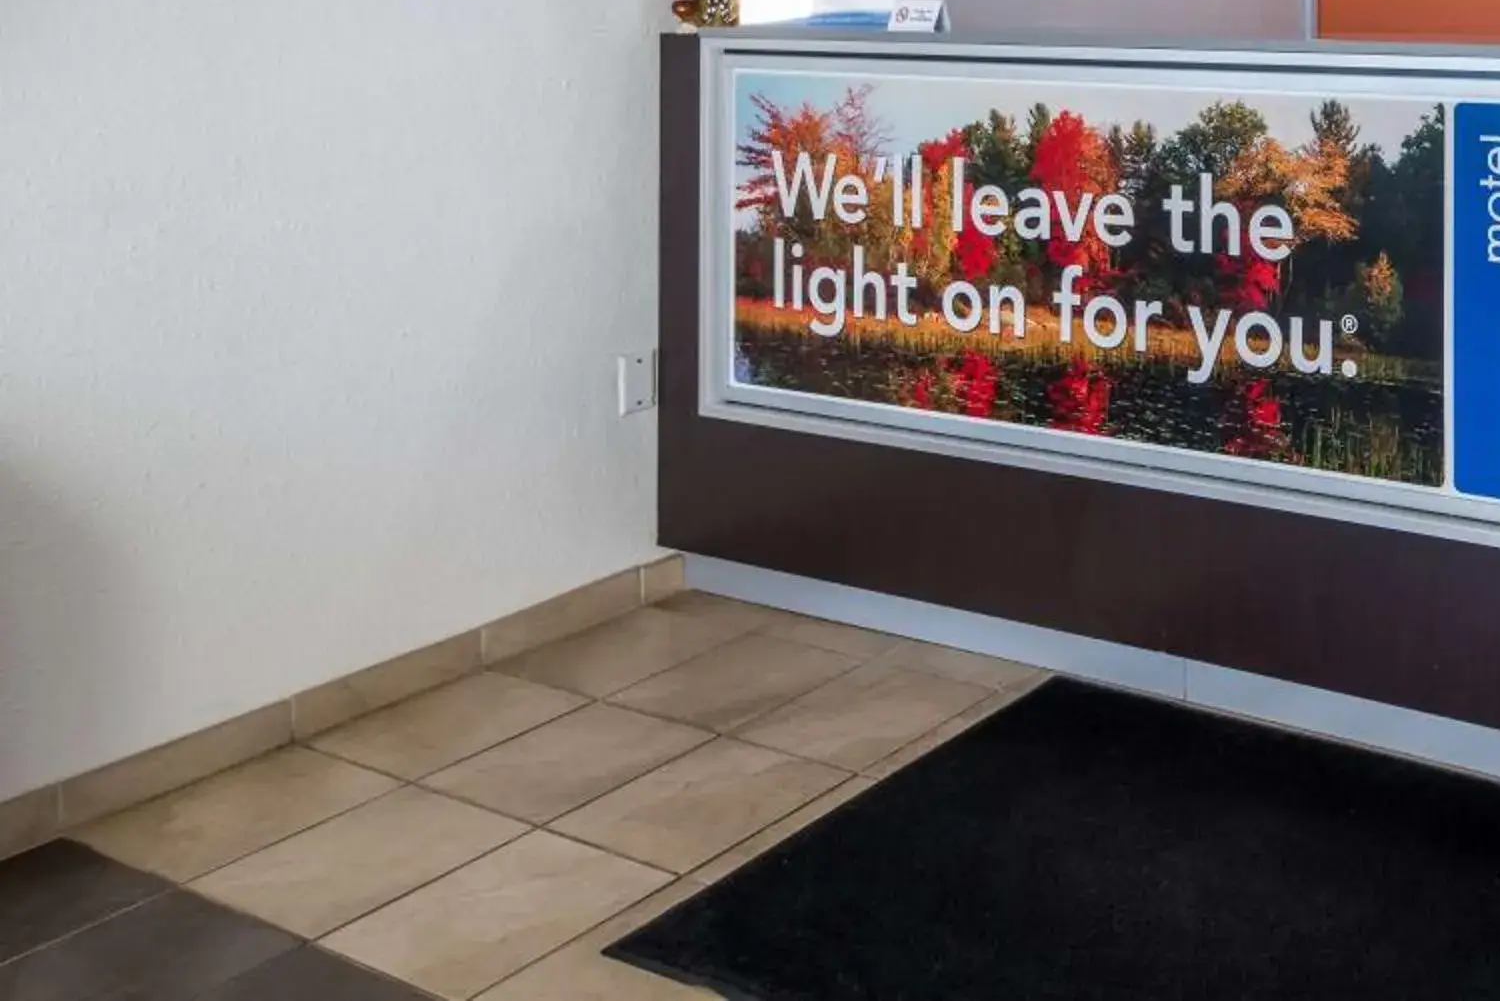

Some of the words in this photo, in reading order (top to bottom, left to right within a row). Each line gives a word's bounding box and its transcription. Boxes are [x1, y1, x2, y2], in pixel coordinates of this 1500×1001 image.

[772, 149, 923, 229] We'll
[953, 156, 1134, 247] leave
[1162, 172, 1294, 262] the
[772, 237, 917, 338] light
[943, 278, 1026, 339] on
[1053, 264, 1163, 351] for
